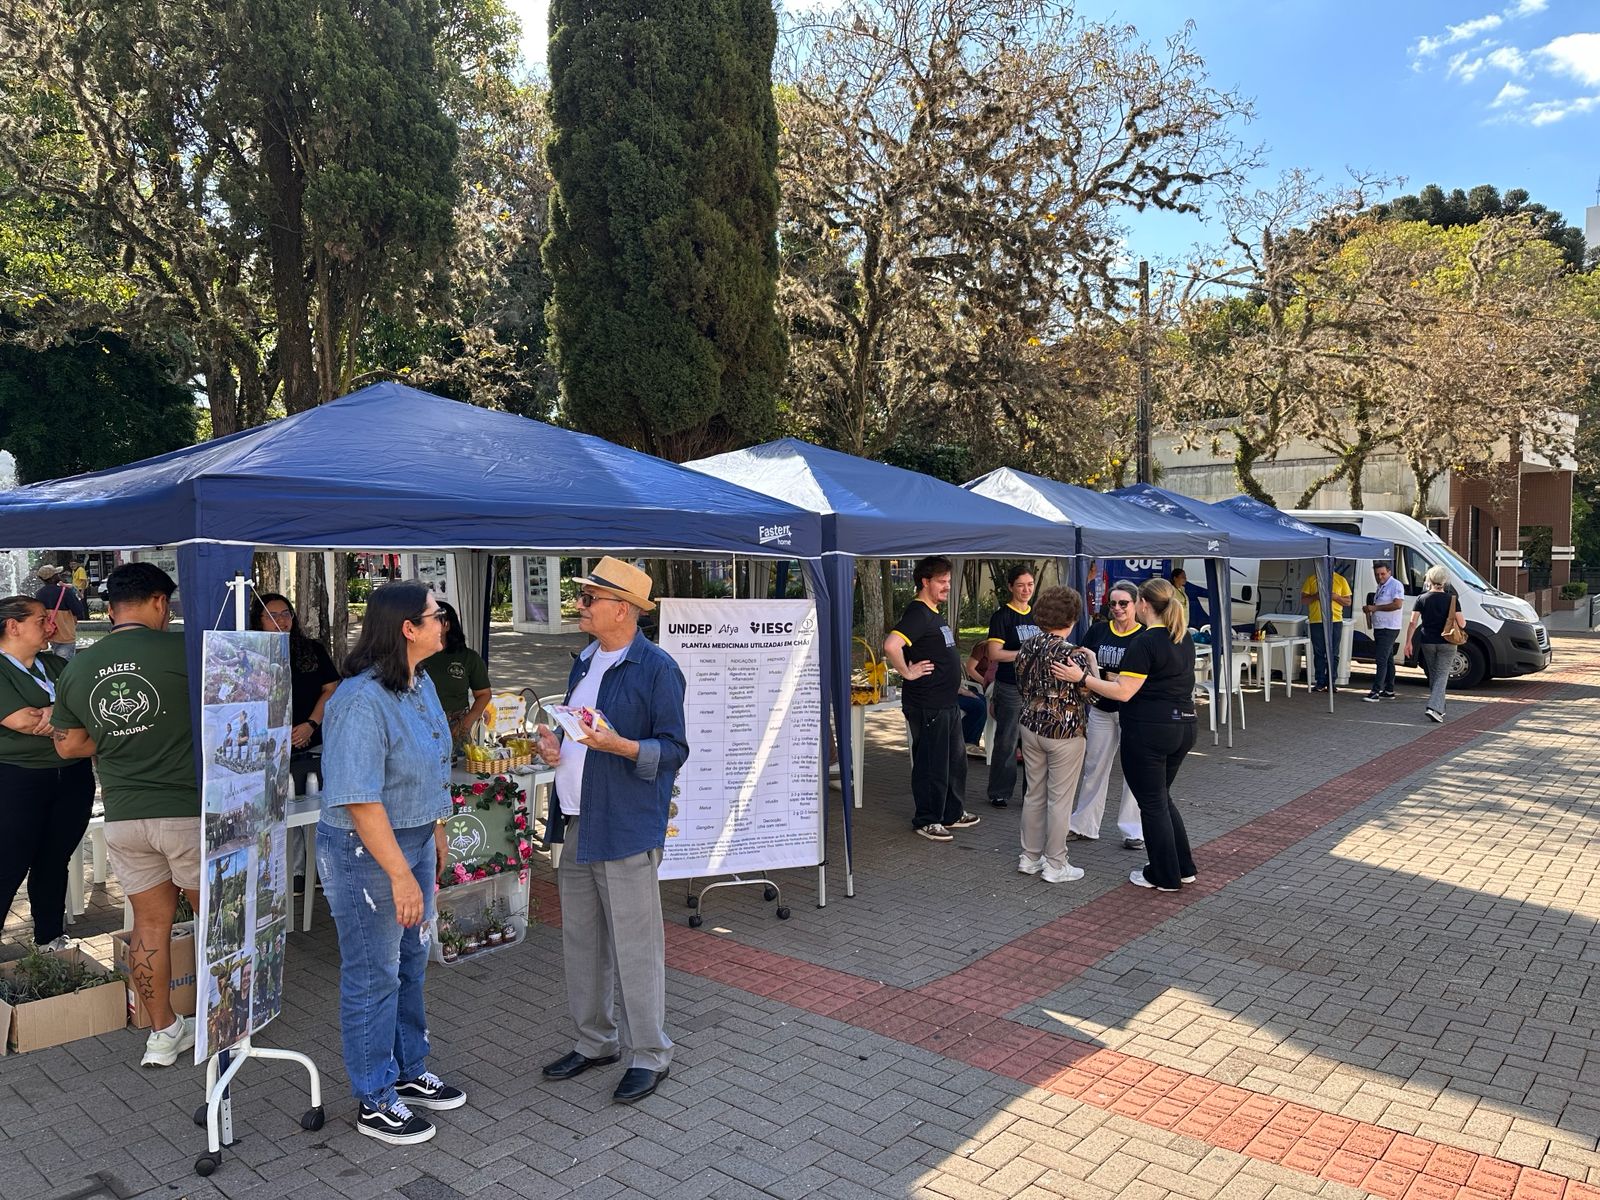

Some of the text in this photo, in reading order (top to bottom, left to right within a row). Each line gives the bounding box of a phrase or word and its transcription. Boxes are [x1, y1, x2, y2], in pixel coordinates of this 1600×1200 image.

[1126, 559, 1163, 572] QUE
[668, 624, 739, 635] UNIDEP Afya
[762, 622, 793, 634] IESC
[99, 662, 136, 678] RAÍZES
